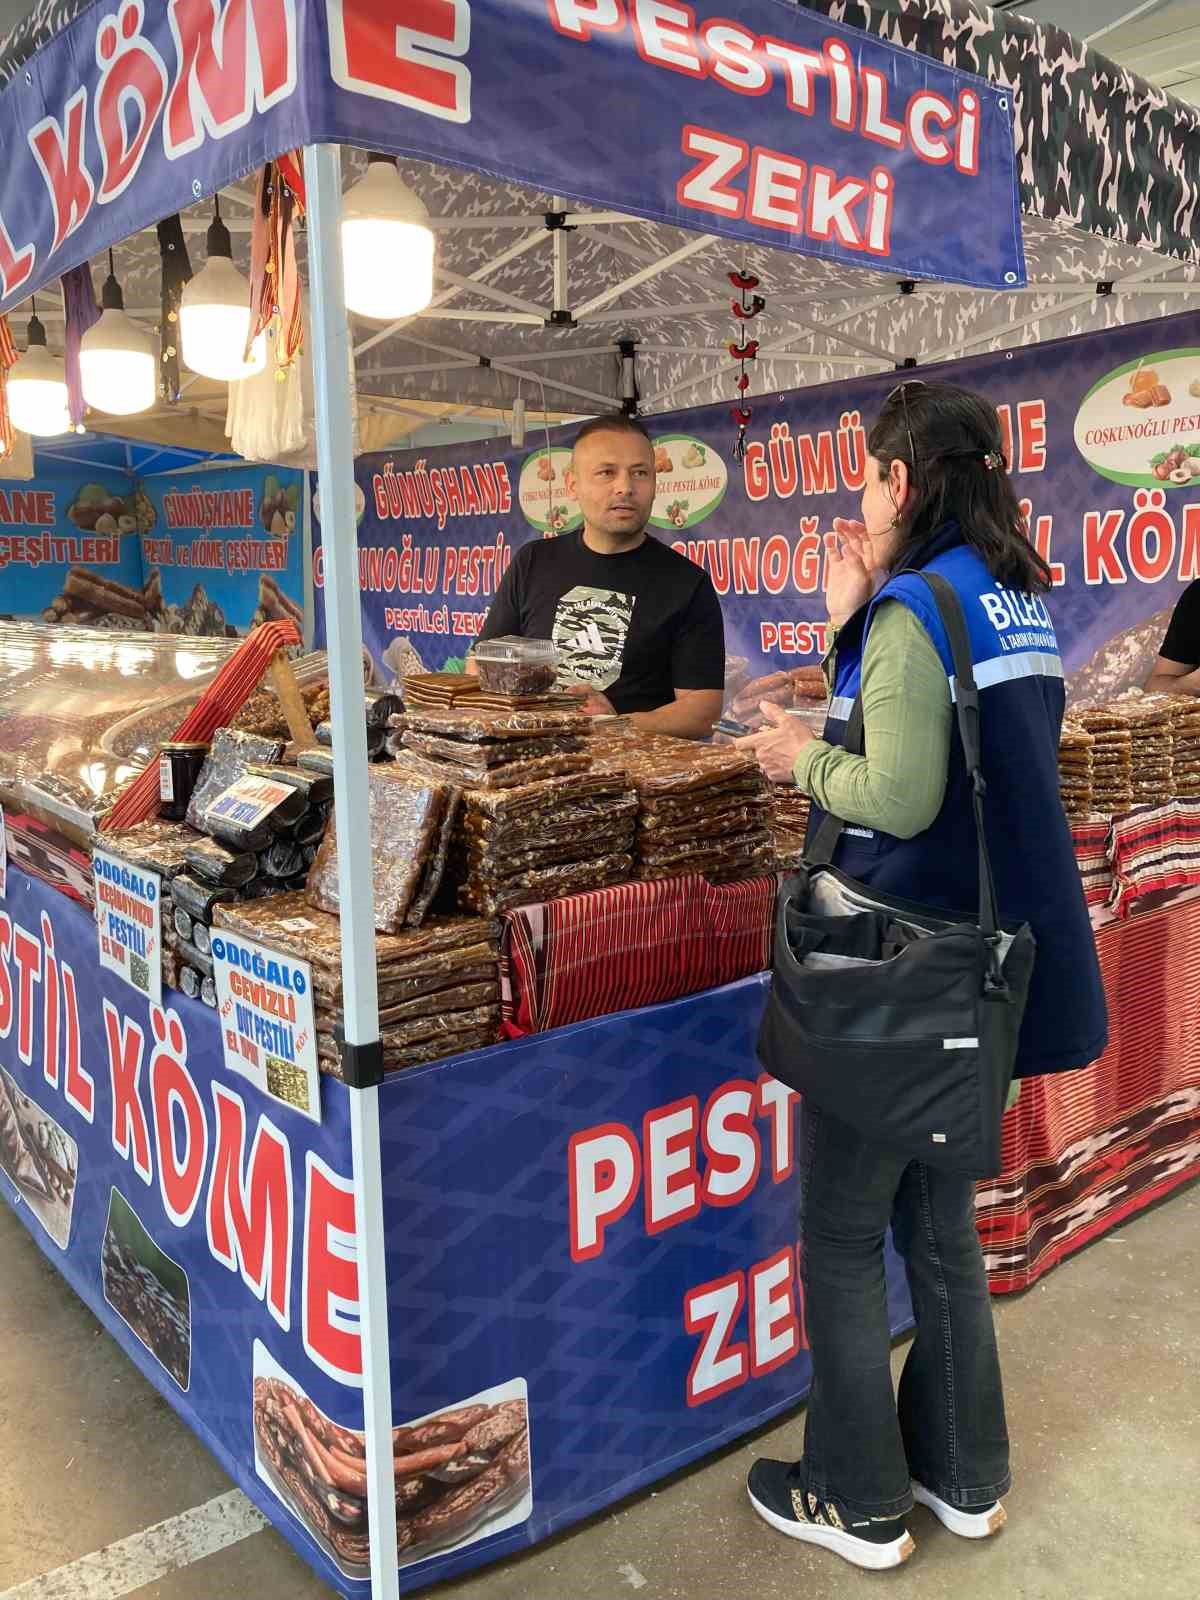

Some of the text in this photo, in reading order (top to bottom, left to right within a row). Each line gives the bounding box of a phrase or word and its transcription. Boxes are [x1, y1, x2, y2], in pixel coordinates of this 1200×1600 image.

[677, 124, 893, 257] ZEKİ
[1084, 418, 1170, 447] COŞKUNOĞLU
[372, 457, 512, 530] GÜMÜŞHANE
[442, 531, 512, 596] PESTİ
[384, 603, 451, 635] PESTİLCİ
[226, 941, 295, 993] DOĞAL
[229, 970, 297, 1024] CEVİZLİ
[102, 997, 364, 1388] KÖME
[684, 1240, 809, 1408] ZE
